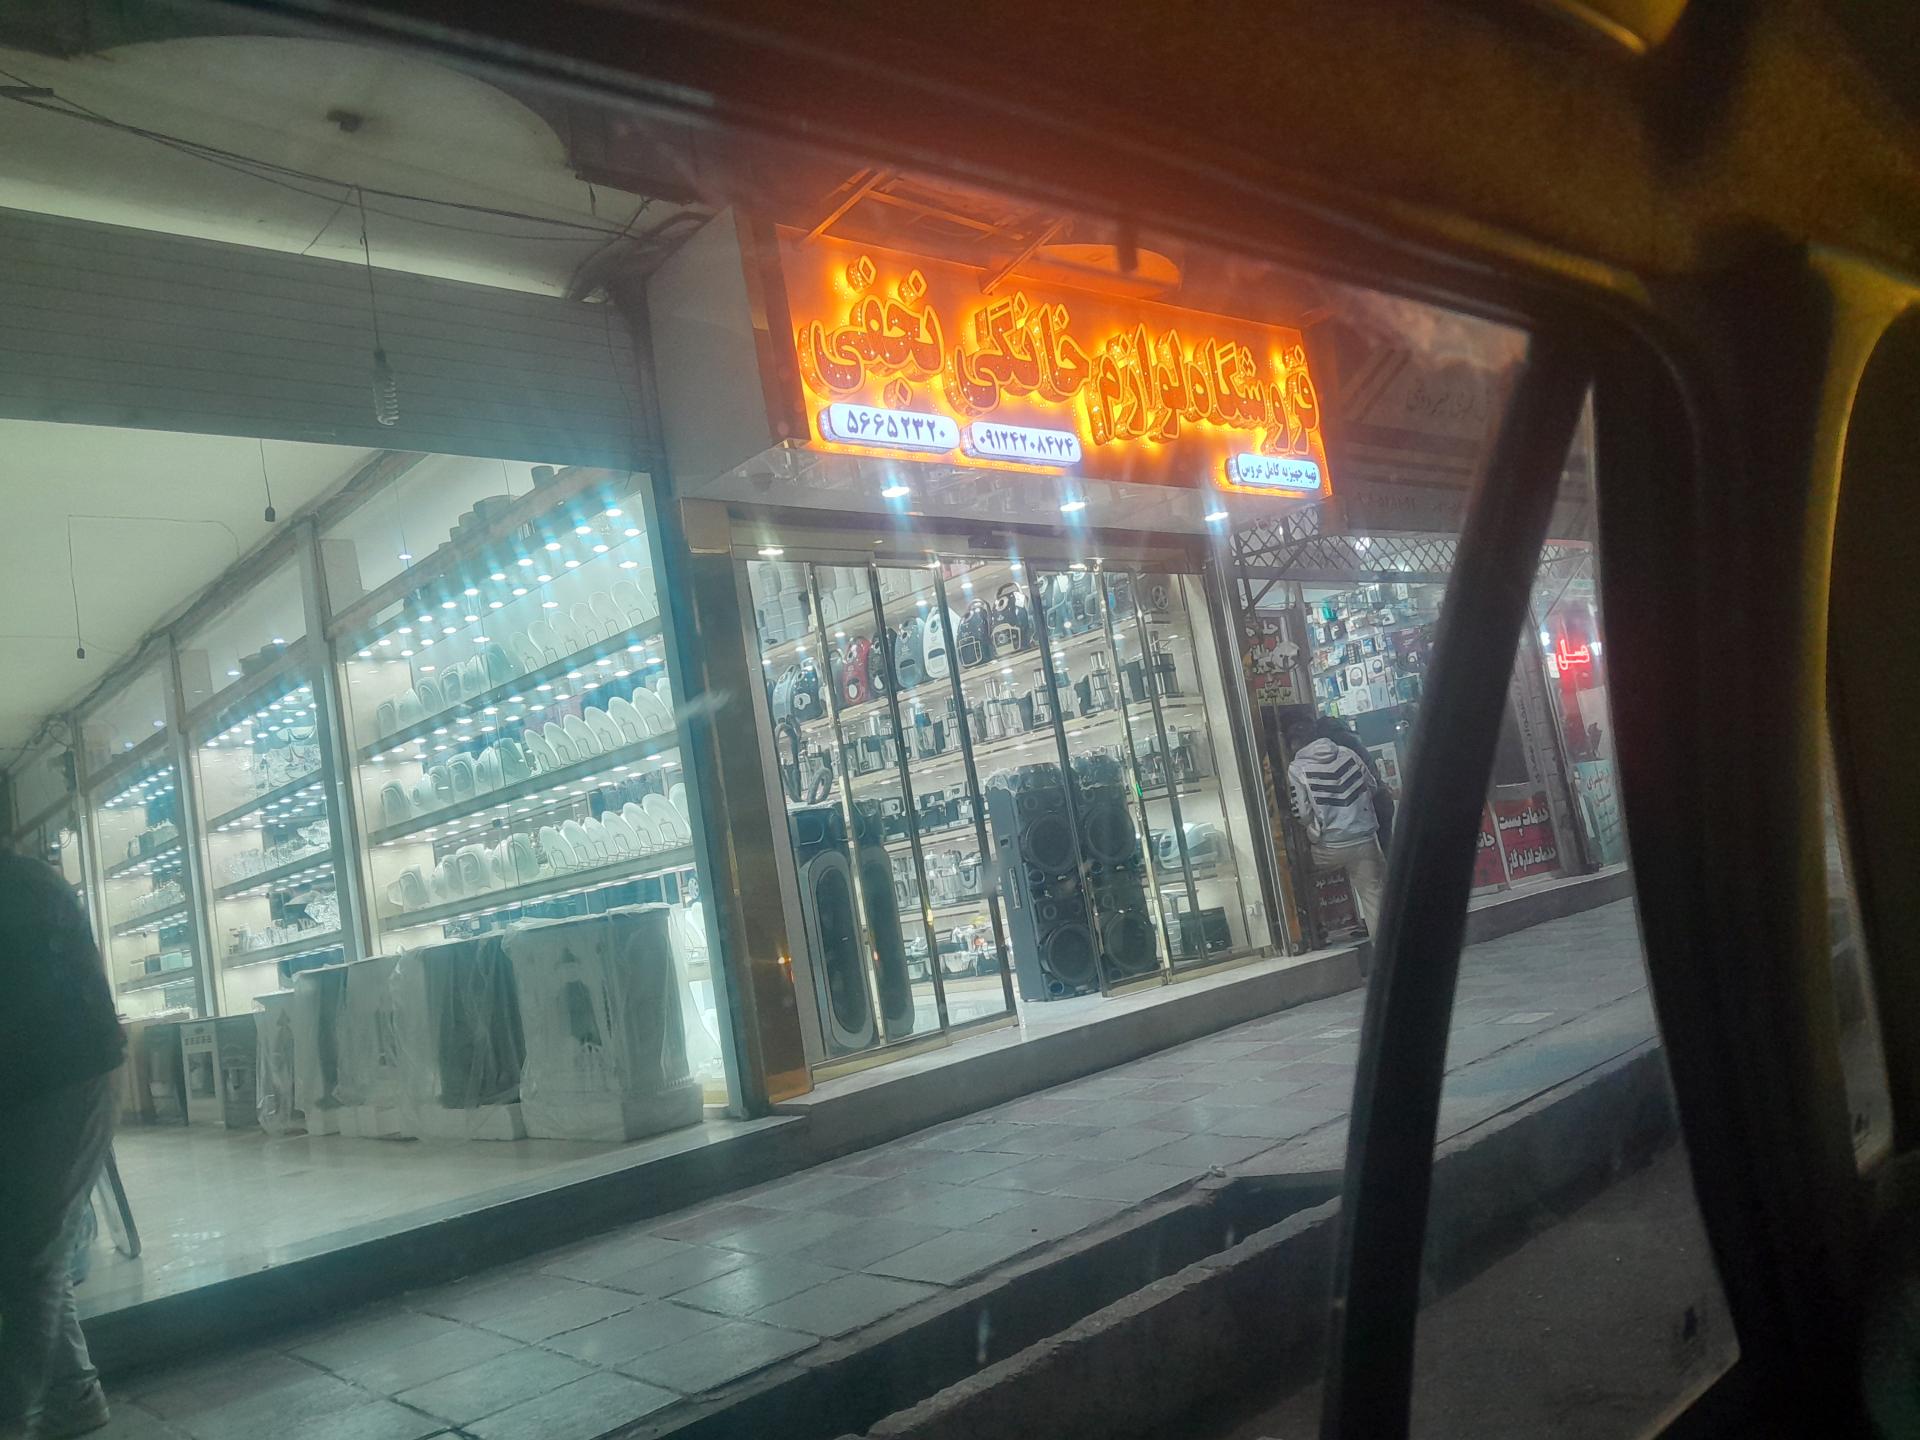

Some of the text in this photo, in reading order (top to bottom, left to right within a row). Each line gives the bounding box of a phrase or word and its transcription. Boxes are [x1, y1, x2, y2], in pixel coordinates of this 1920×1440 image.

[804, 255, 1320, 455] فروشگاه لوازم خانگی نجفی
[847, 409, 946, 442] ۵۶۶۵۲۳۲۰
[979, 428, 1073, 457] ۰۹۱۲۴۲۰۸۴۷۴
[1241, 465, 1262, 479] عروس
[1264, 461, 1280, 479] کامل
[1499, 804, 1551, 837] خدمات پست
